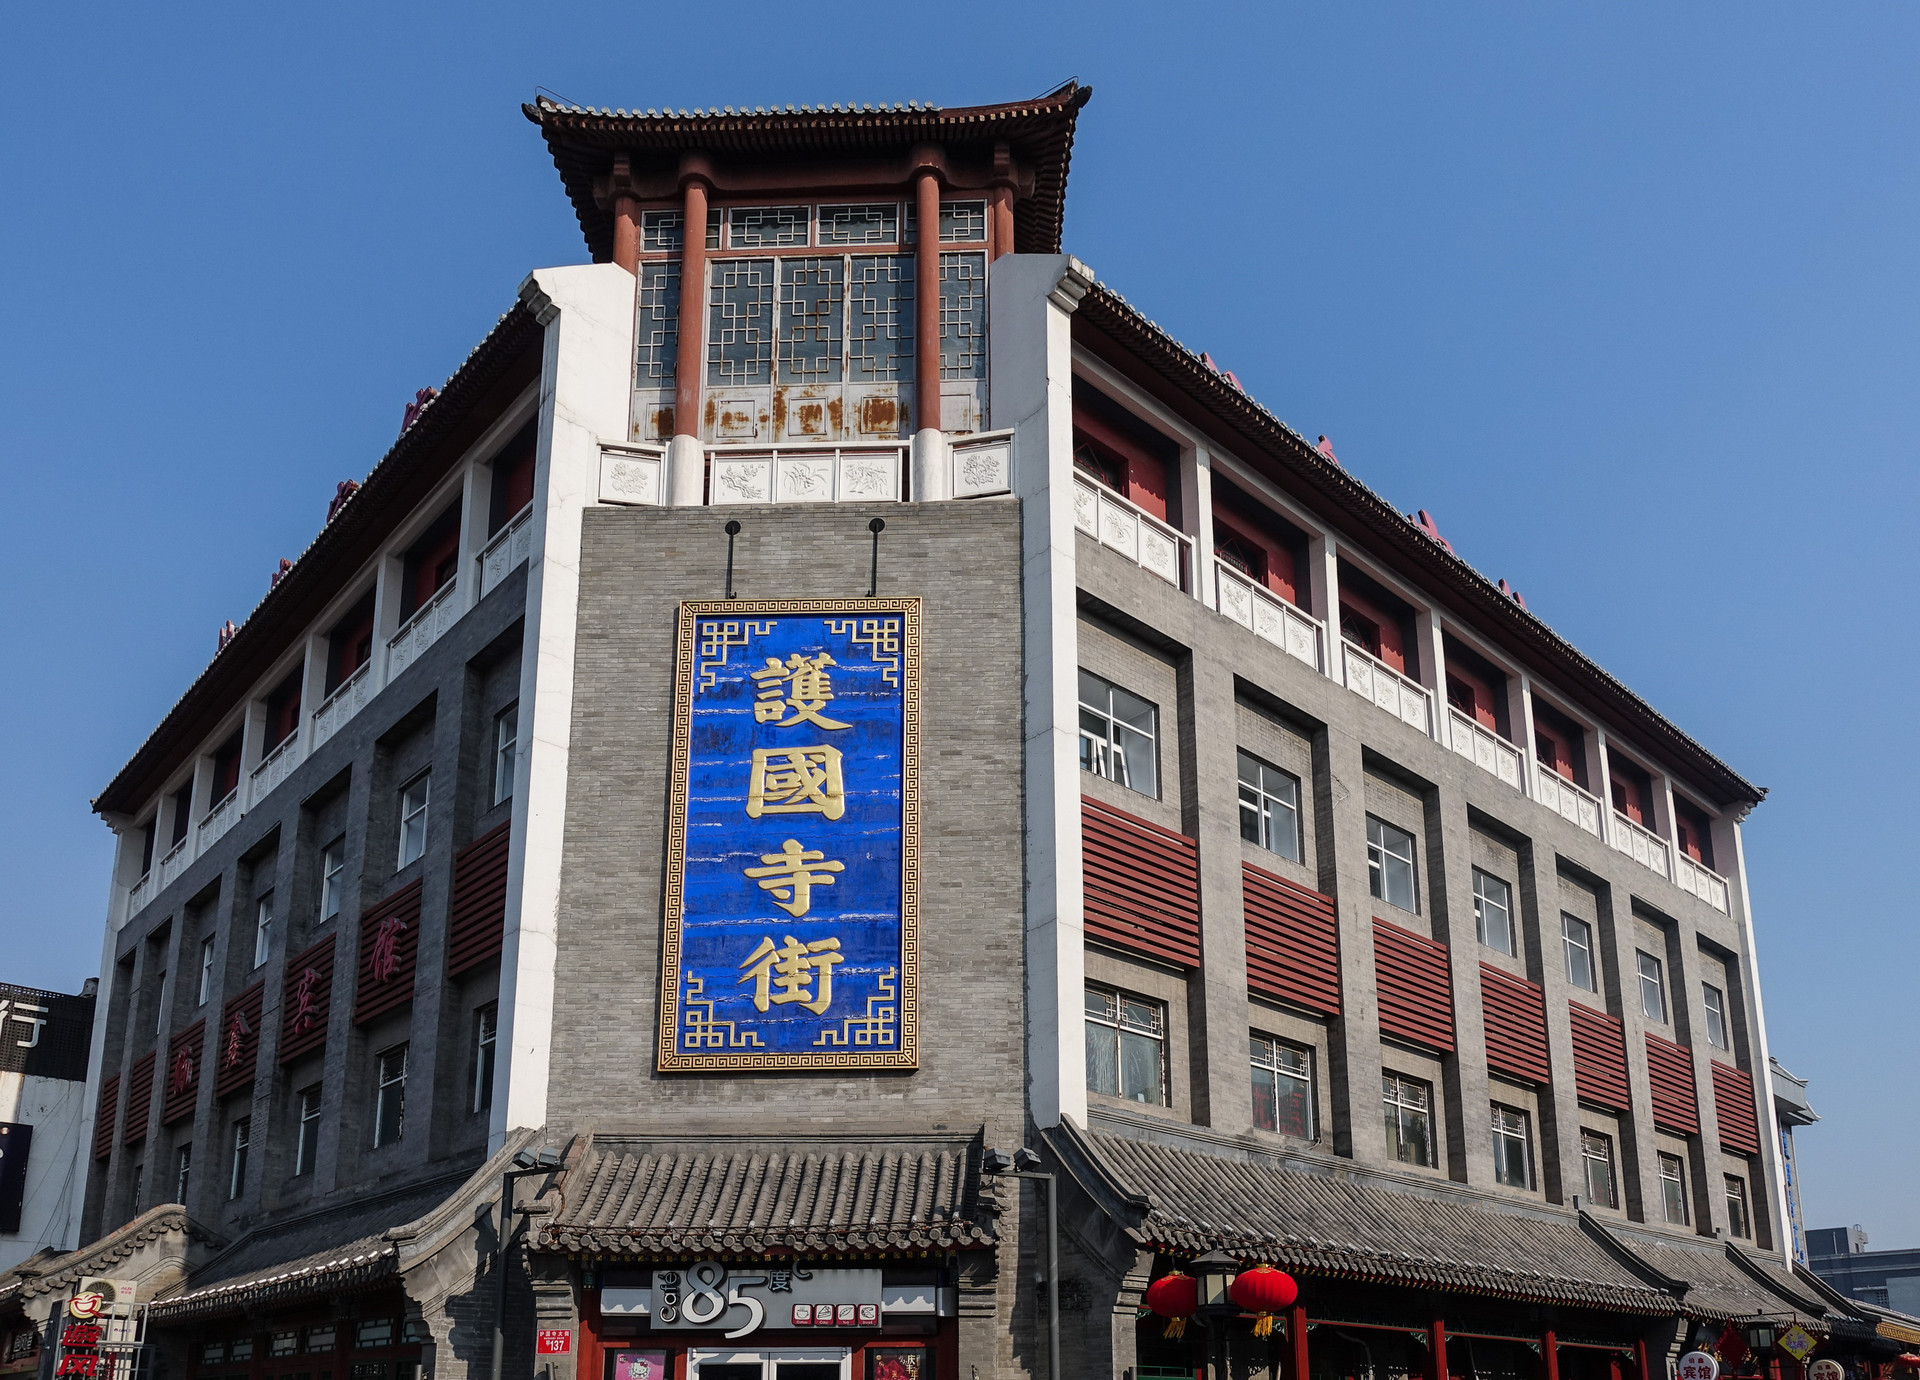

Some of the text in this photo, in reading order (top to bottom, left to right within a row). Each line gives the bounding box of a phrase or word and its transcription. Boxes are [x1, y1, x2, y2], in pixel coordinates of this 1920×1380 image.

[738, 652, 853, 1016] 護國寺街
[659, 1272, 679, 1323] Café
[1683, 1366, 1711, 1379] 宾馆
